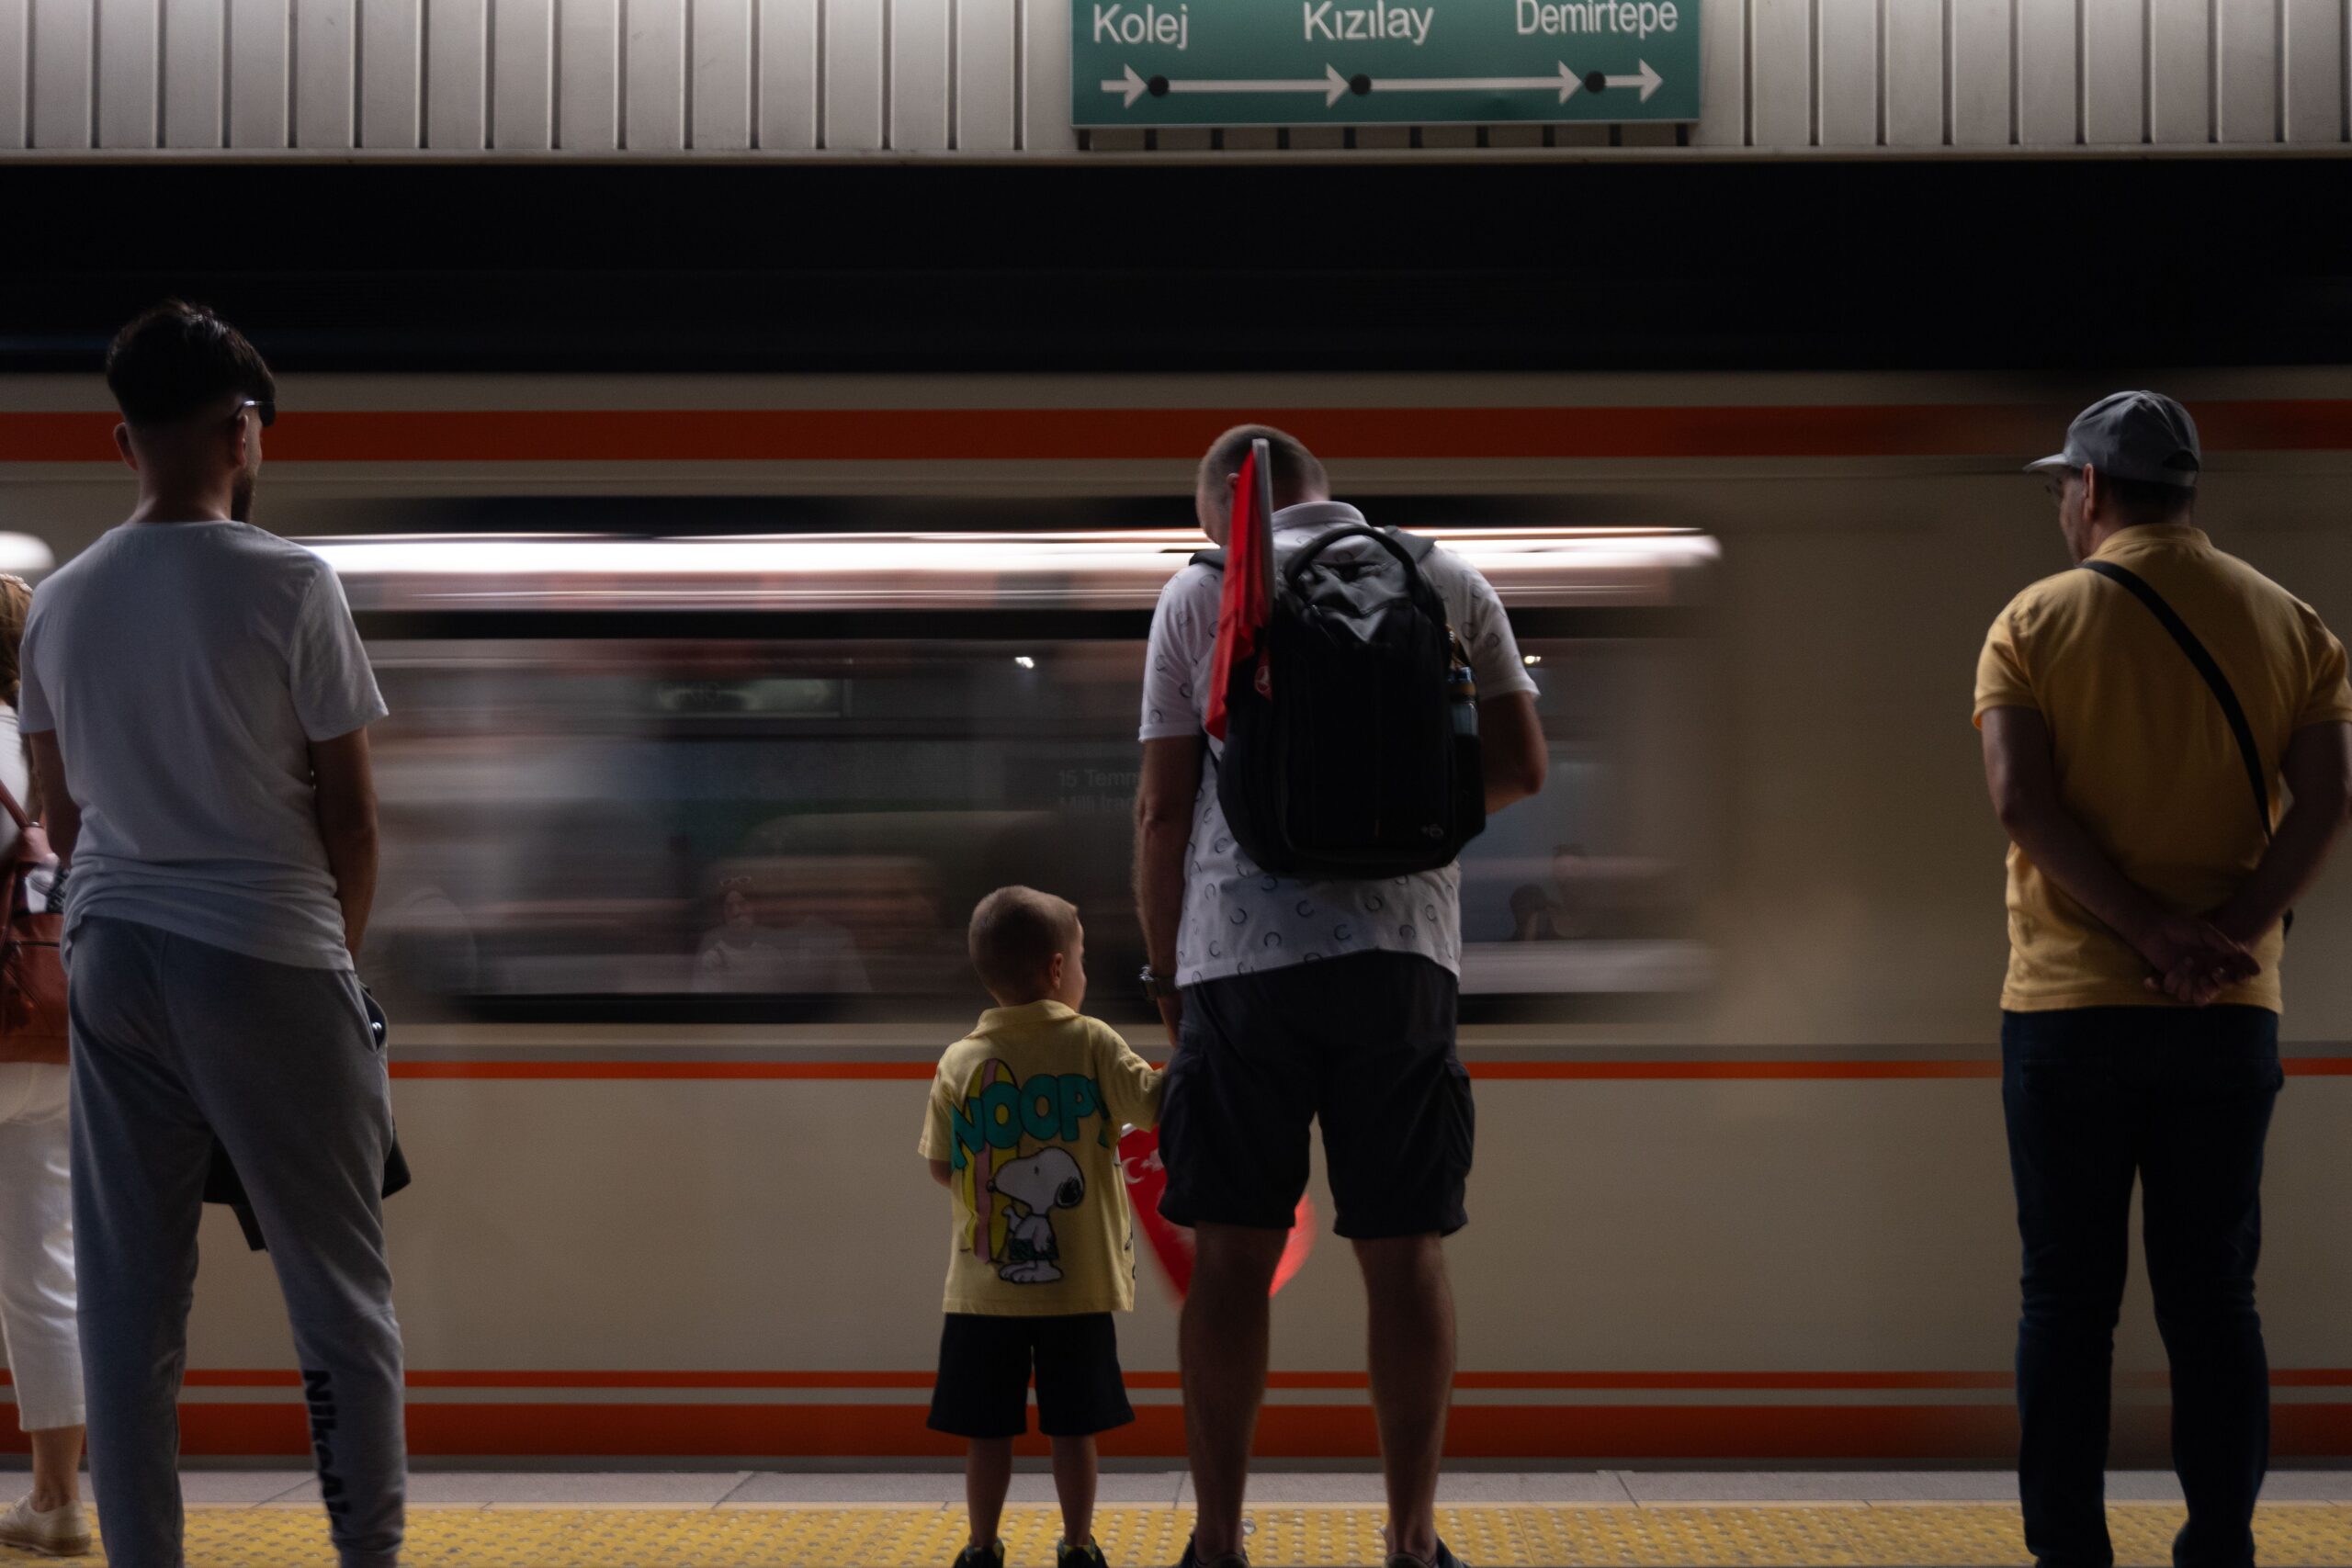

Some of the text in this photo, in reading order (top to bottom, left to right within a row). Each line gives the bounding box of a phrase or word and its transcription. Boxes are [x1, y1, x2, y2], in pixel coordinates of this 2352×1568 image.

[1092, 2, 1188, 51] Kolej
[1303, 1, 1435, 46] Kızılay
[1516, 0, 1679, 39] Demirtepe
